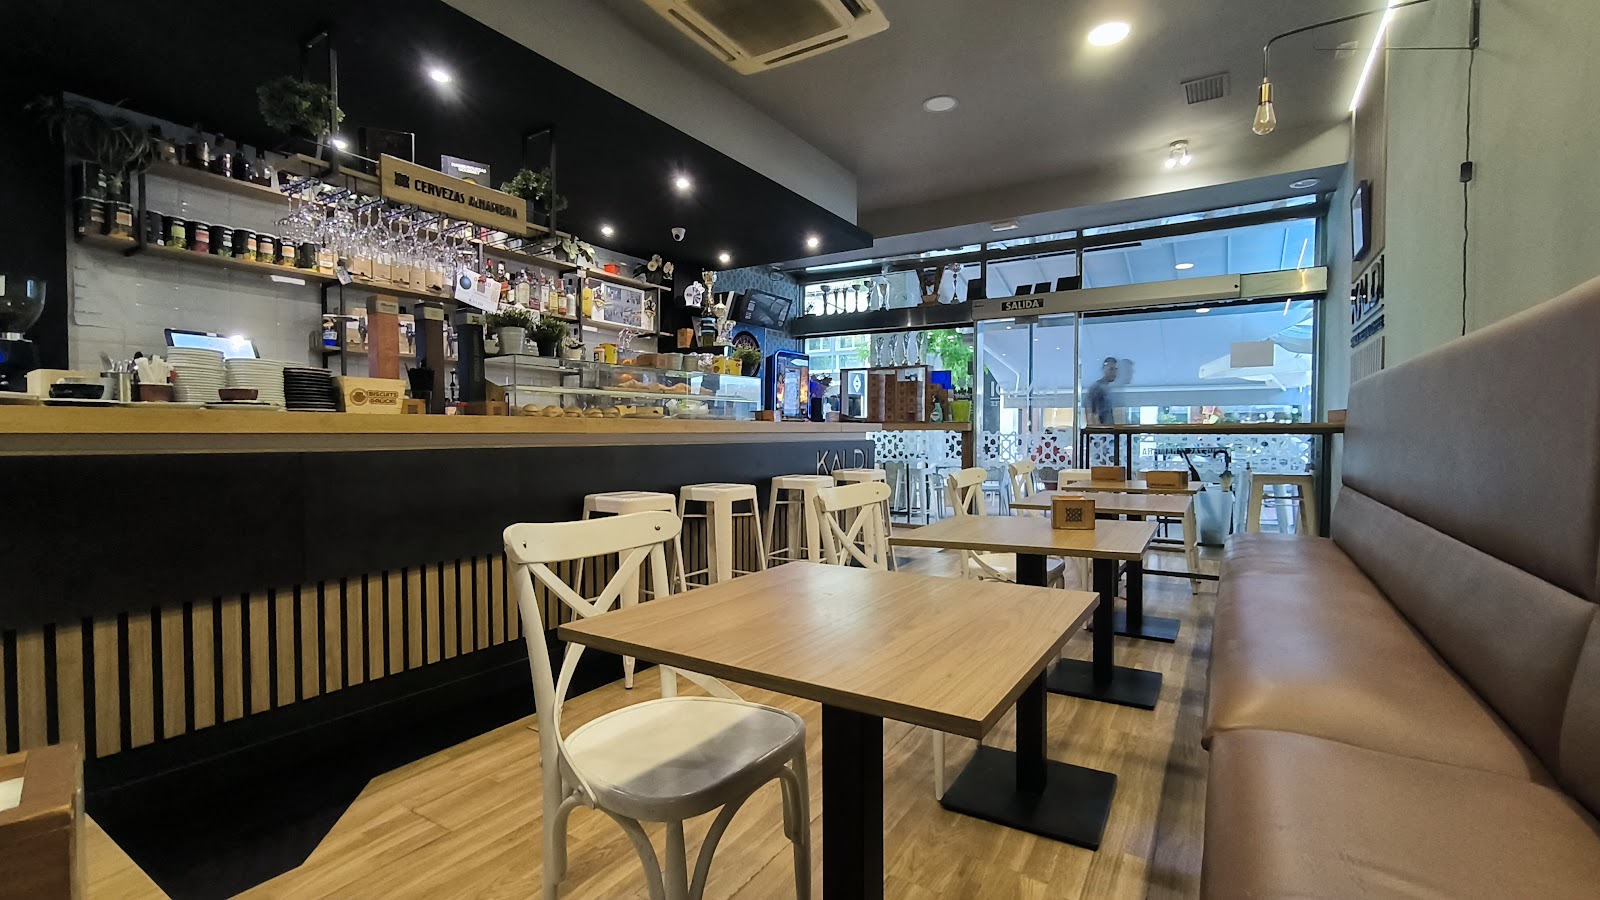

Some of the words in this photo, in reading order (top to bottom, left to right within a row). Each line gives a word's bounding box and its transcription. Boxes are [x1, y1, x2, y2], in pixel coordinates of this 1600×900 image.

[414, 179, 465, 204] CERVEZAS
[468, 195, 518, 219] ALHAMBRA
[1005, 299, 1040, 311] SALIDA
[816, 448, 869, 475] KALDI
